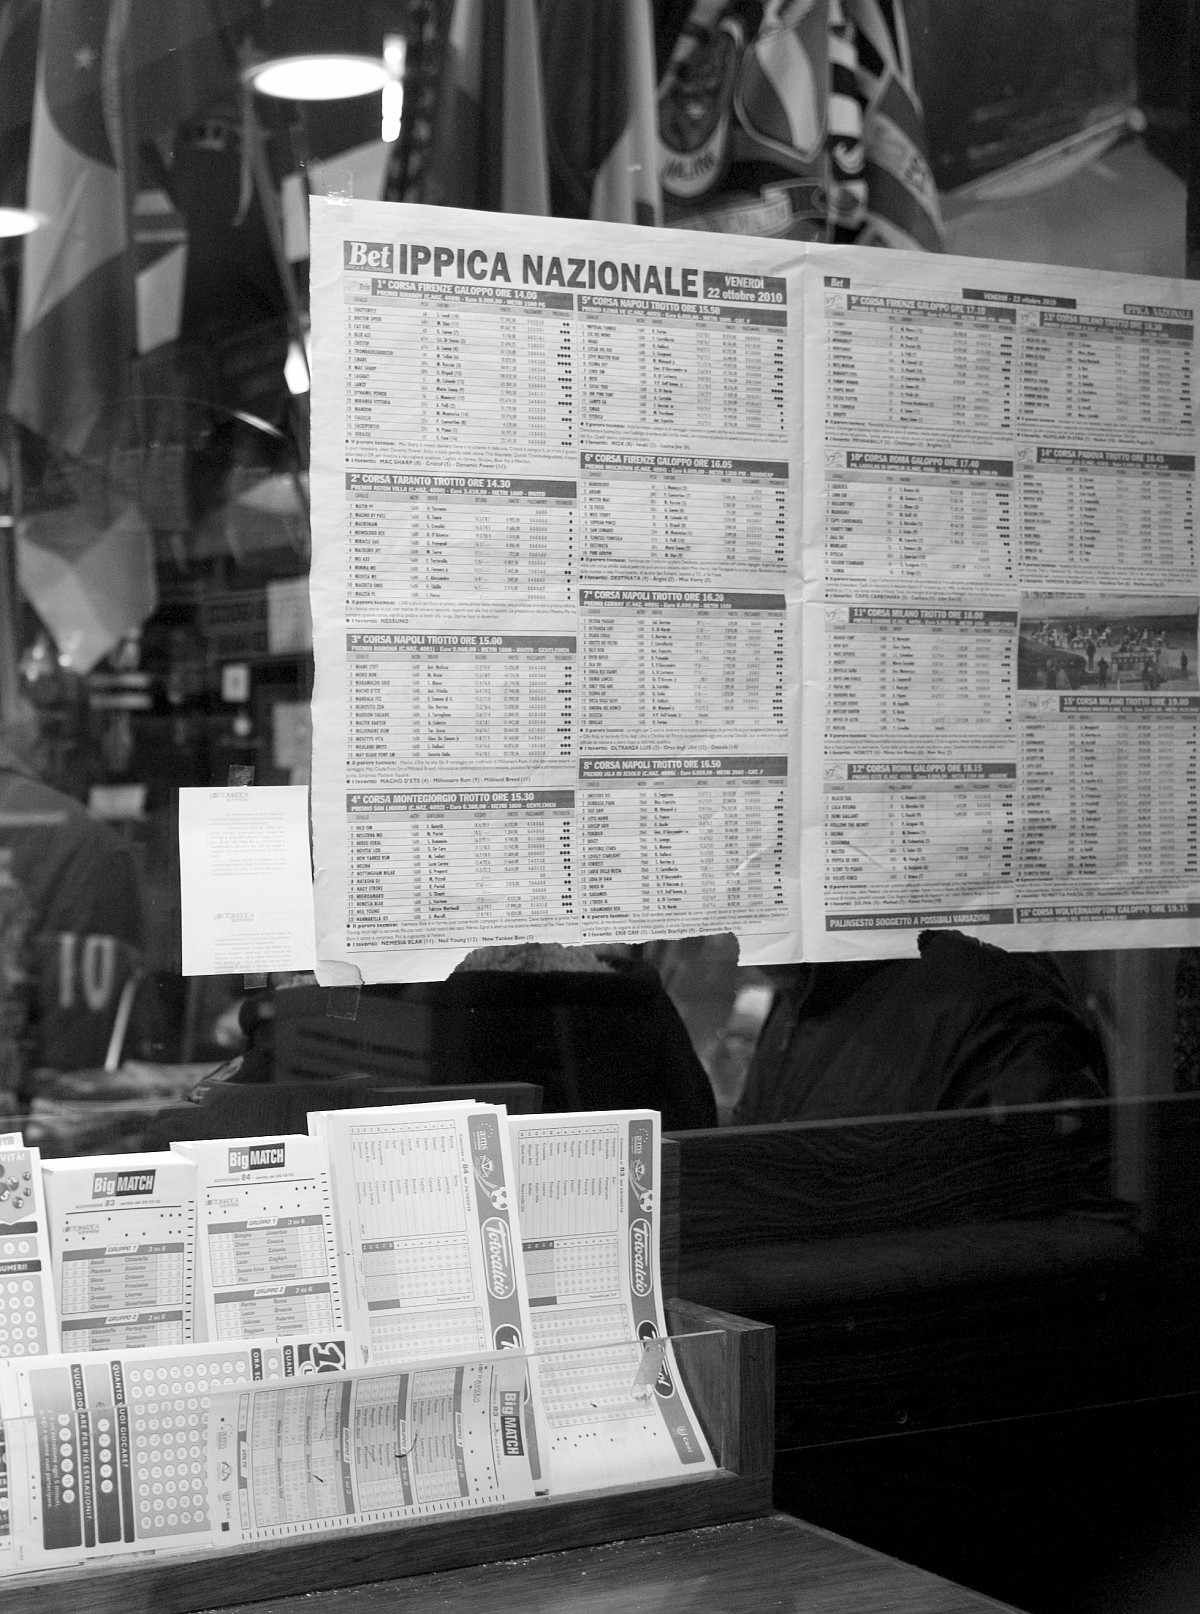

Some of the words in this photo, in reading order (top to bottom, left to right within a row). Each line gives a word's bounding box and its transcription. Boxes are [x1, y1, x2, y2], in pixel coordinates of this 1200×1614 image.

[350, 241, 390, 268] Bet
[400, 243, 511, 283] IPPICA
[522, 254, 699, 298] NAZIONALE
[387, 280, 417, 291] CORSA
[418, 282, 453, 293] FIRENZE
[453, 285, 494, 296] GALOPPO
[494, 288, 513, 298] ORE
[513, 289, 538, 300] 14.00
[707, 287, 721, 298] 22
[722, 289, 755, 301] ottobre
[757, 291, 784, 303] 2010
[591, 297, 619, 307] CORSA
[619, 299, 650, 310] NAPOLI
[650, 301, 680, 312] TROTTO
[681, 304, 698, 313] ORE
[699, 305, 721, 315] 15.50
[595, 453, 622, 463] CORSA
[623, 455, 656, 465] FIRENZE
[656, 457, 692, 467] GALOPPO
[693, 459, 709, 468] ORE
[710, 460, 733, 469] 16.05
[363, 474, 391, 484] CORSA
[392, 475, 431, 485] TARANTO
[432, 477, 466, 487] TROTTO
[468, 478, 484, 487] ORE
[486, 479, 511, 488] 14.30
[594, 591, 621, 600] CORSA
[622, 591, 650, 600] NAPOLI
[651, 592, 683, 601] TROTTO
[683, 593, 701, 601] ORE
[702, 593, 724, 602] 16.20
[362, 635, 391, 644] CORSA
[394, 635, 425, 644] NAPOLI
[426, 636, 459, 645] TROTTO
[460, 636, 477, 645] ORE
[479, 636, 503, 645] 15.00
[593, 761, 621, 770] CORSA
[622, 760, 650, 769] NAPOLI
[652, 760, 682, 769] TROTTO
[683, 760, 699, 768] ORE
[700, 760, 722, 768] 16.50
[362, 794, 392, 804] CORSA
[393, 793, 457, 803] MONTEGIORGIO
[458, 793, 490, 802] TROTTO
[492, 792, 510, 802] ORE
[510, 792, 534, 801] 15.30
[830, 918, 874, 928] PALINSESTO
[875, 916, 912, 926] SOGGETTO
[913, 916, 919, 925] A
[920, 915, 952, 924] POSSIBILI
[952, 913, 991, 923] VARIAZIONI
[485, 1221, 508, 1295] Totocalcio
[633, 1222, 648, 1294] Totocalcio
[112, 1363, 123, 1399] QUANTO
[120, 1422, 129, 1468] GIOCARE?
[72, 1367, 82, 1391] VUOI
[83, 1464, 92, 1519] ESTRAZIONI?
